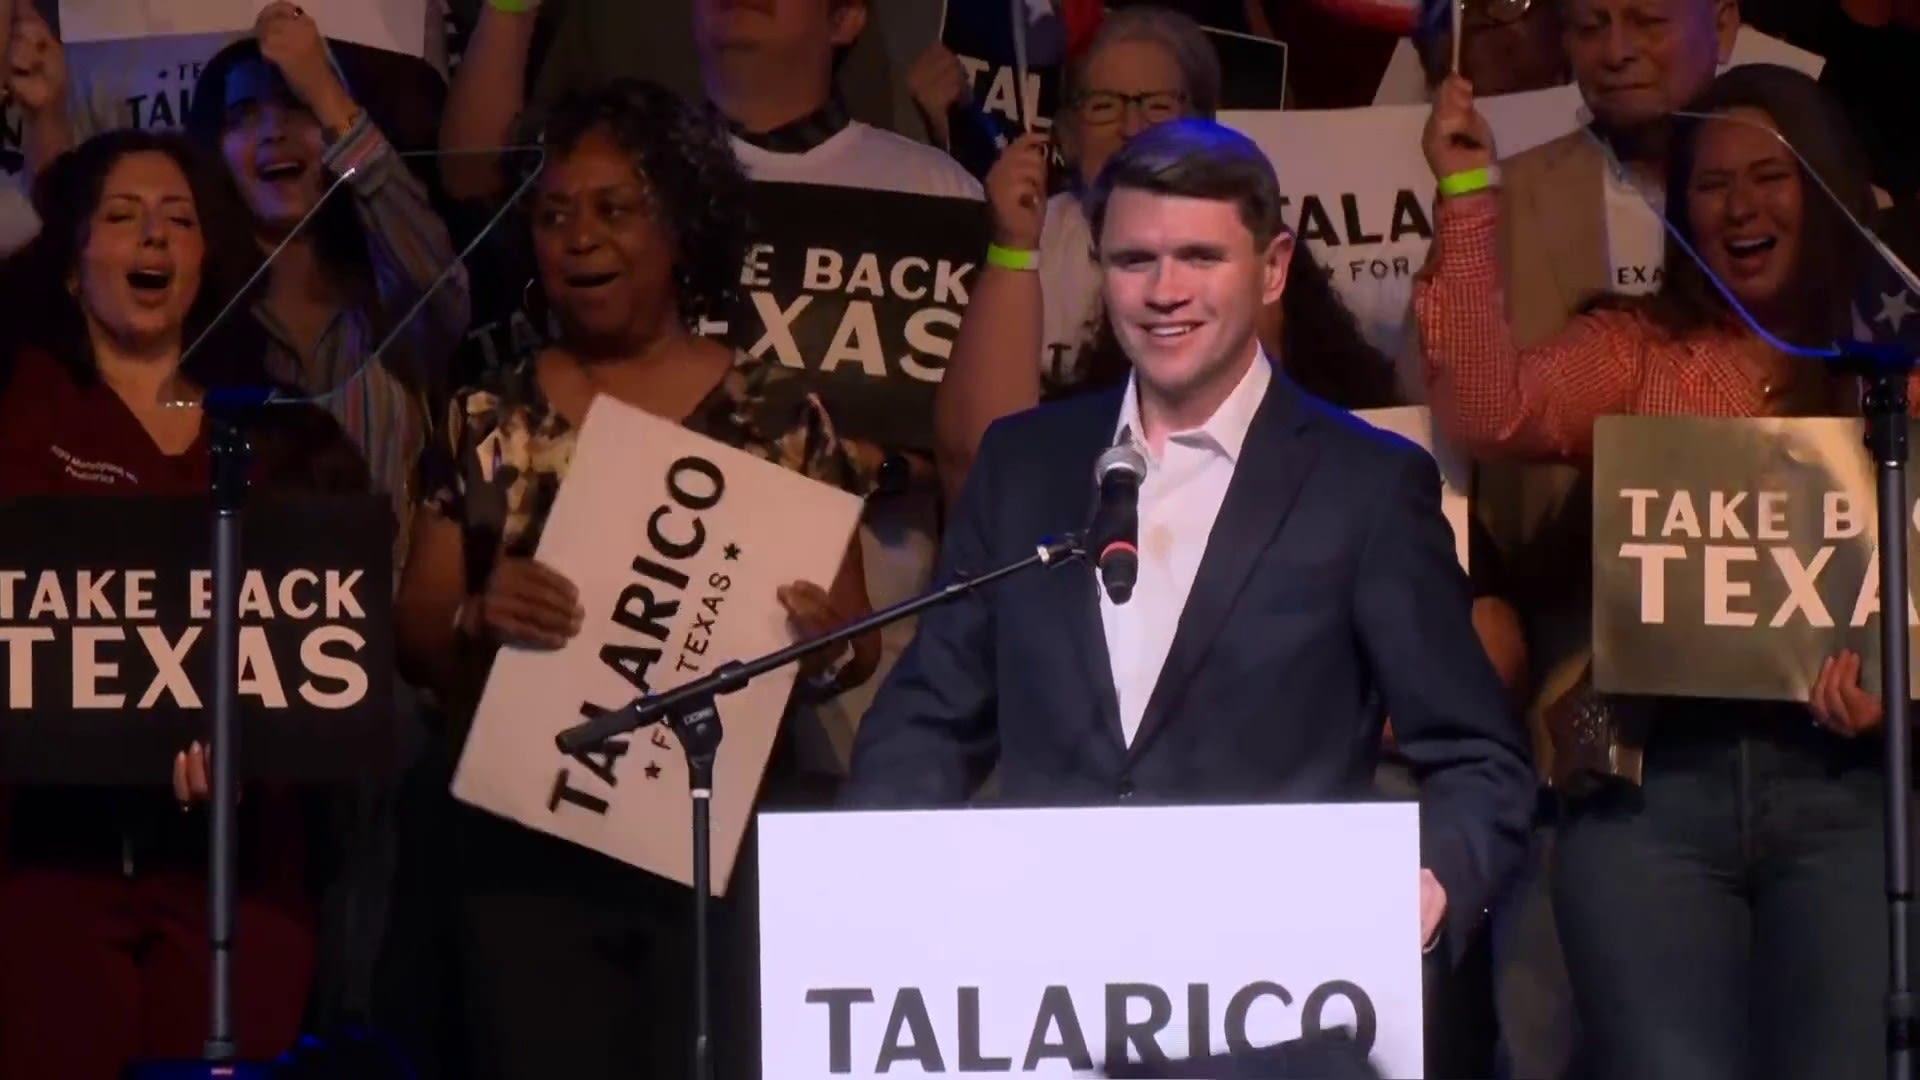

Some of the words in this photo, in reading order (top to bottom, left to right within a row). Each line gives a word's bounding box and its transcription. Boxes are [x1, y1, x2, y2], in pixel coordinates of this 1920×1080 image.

[801, 247, 976, 305] BACK
[1349, 255, 1410, 282] FOR
[1619, 488, 1791, 541] TAKE
[0, 568, 158, 619] TAKE
[674, 571, 731, 674] TEXAS
[0, 623, 370, 710] TEXAS
[805, 979, 1379, 1075] TALARICO
